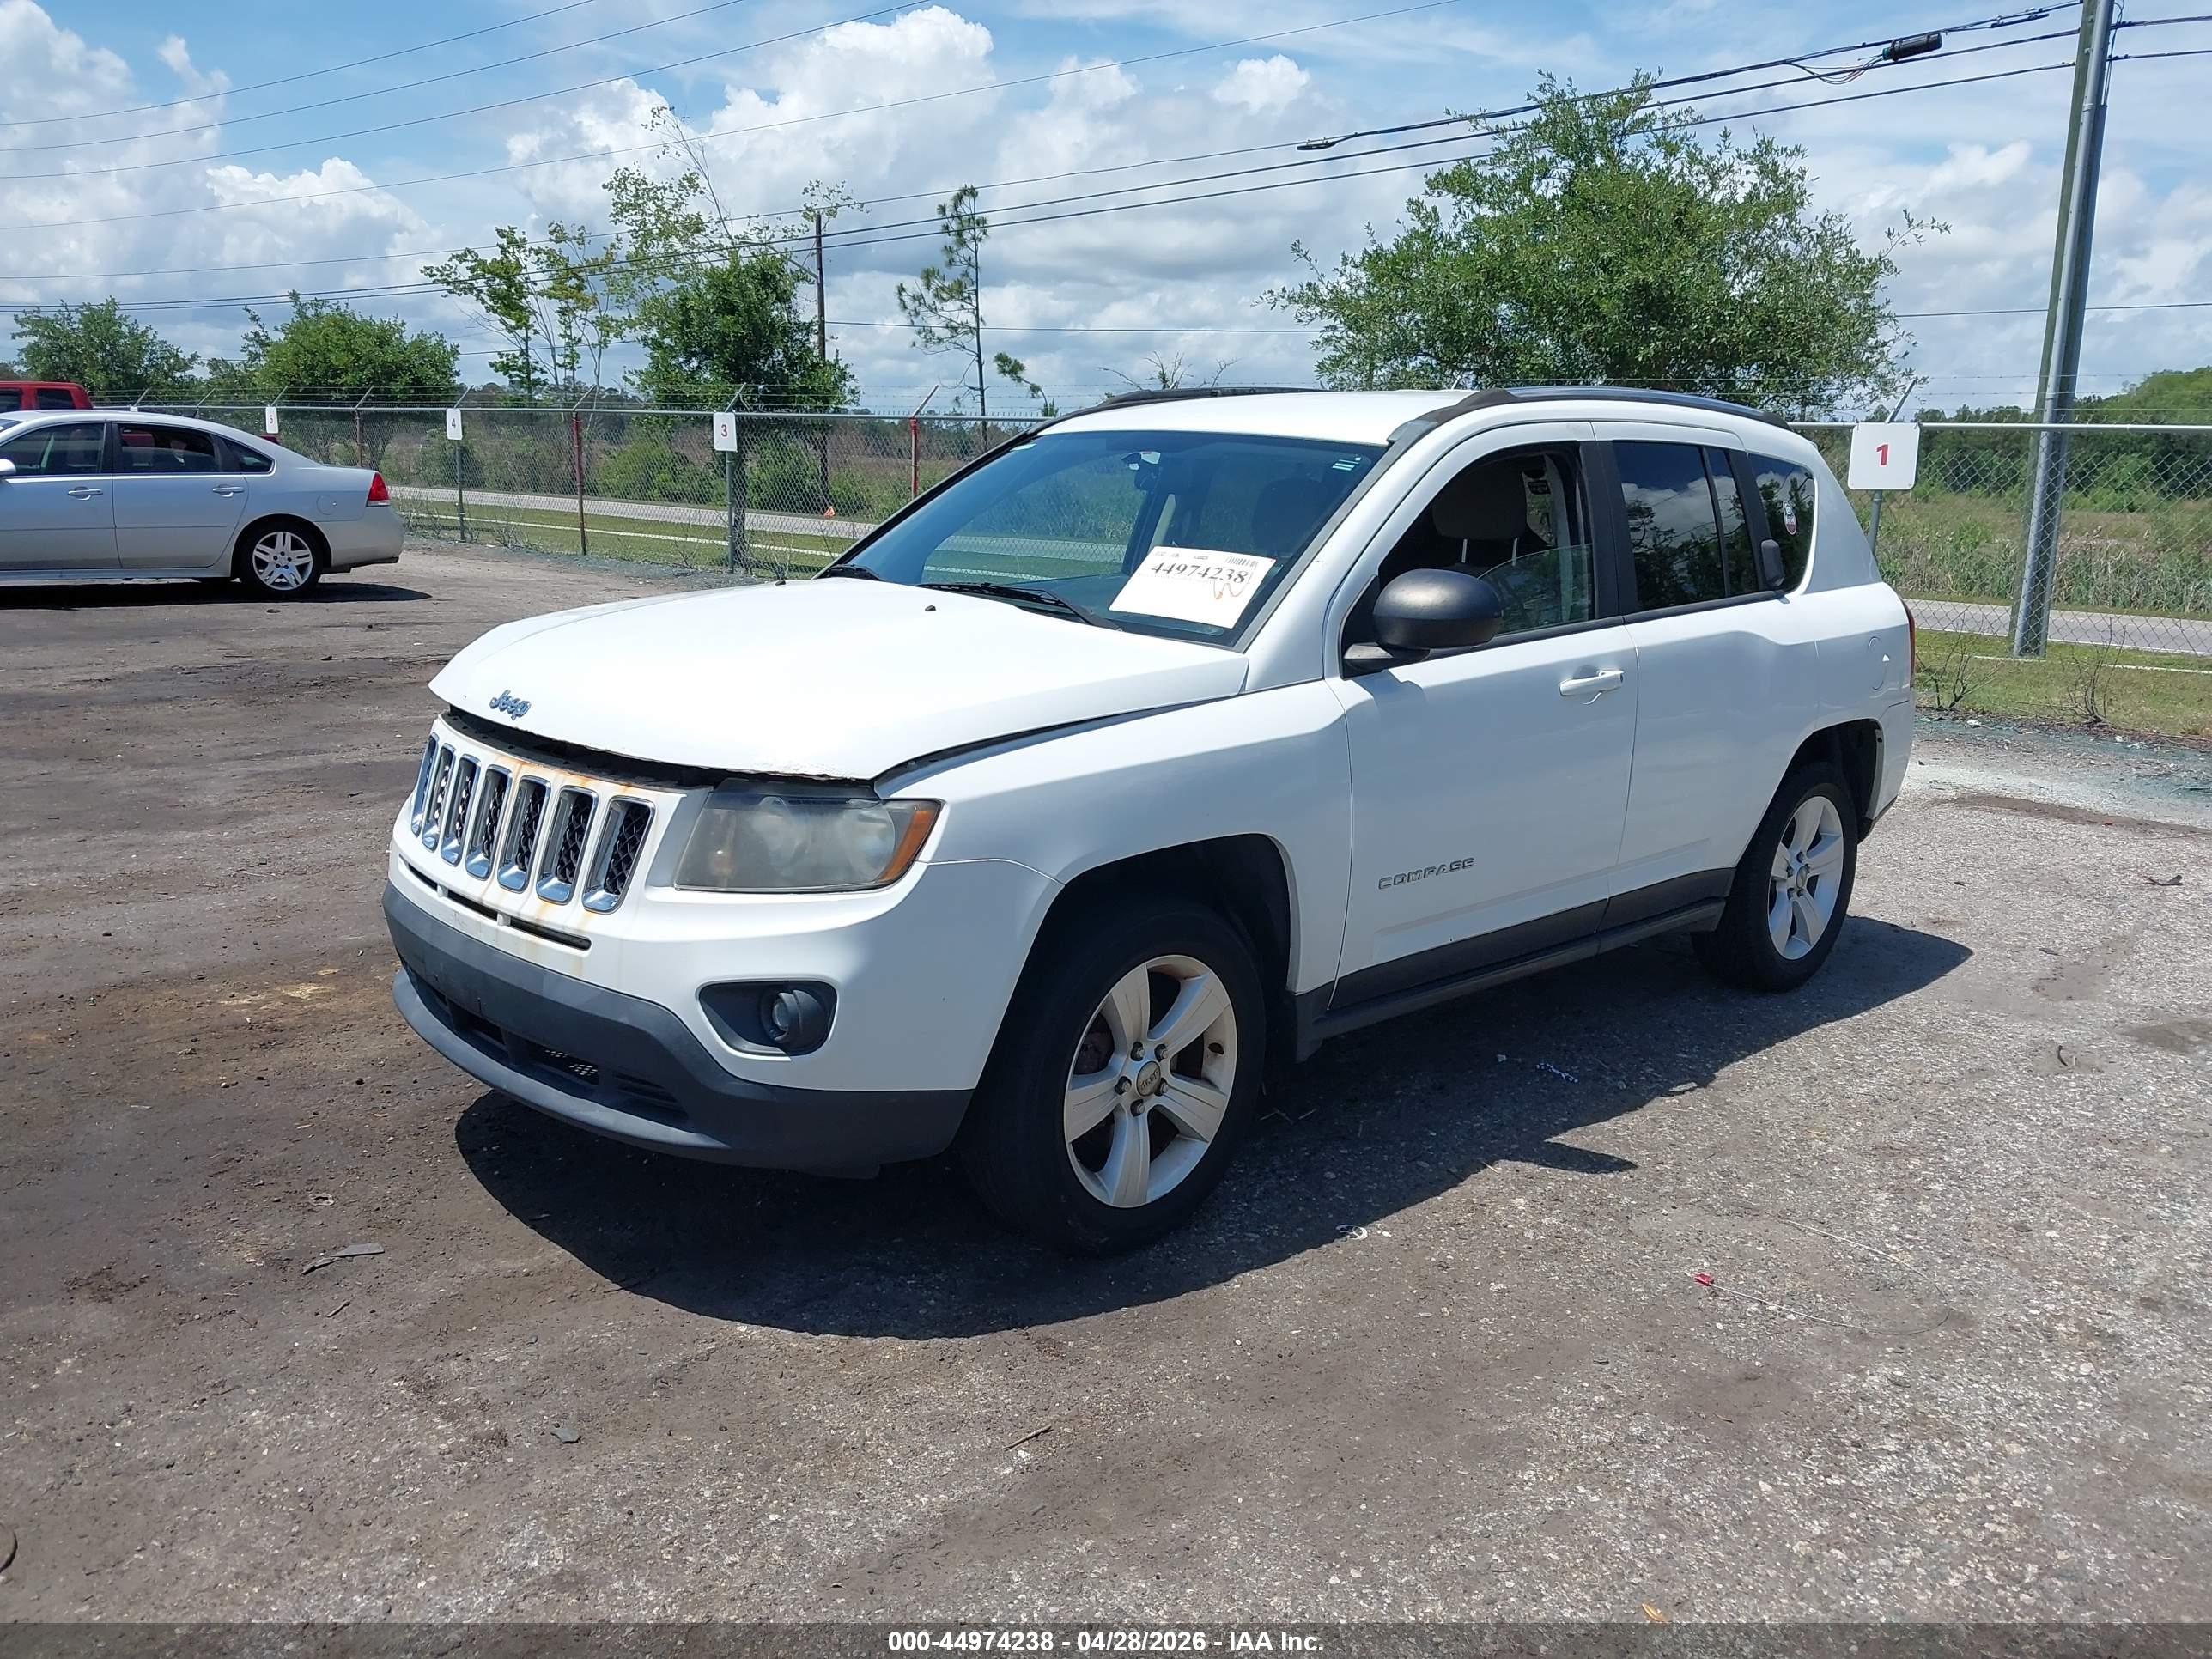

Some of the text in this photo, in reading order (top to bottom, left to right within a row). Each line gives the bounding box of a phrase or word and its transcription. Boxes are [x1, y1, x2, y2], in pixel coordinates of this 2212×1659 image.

[269, 414, 274, 424] 5
[451, 418, 457, 428] 4
[720, 423, 728, 437] 3
[1875, 443, 1889, 465] 1
[1151, 562, 1249, 584] 44974238
[489, 689, 532, 720] Jeep
[1378, 857, 1475, 890] COMPASS
